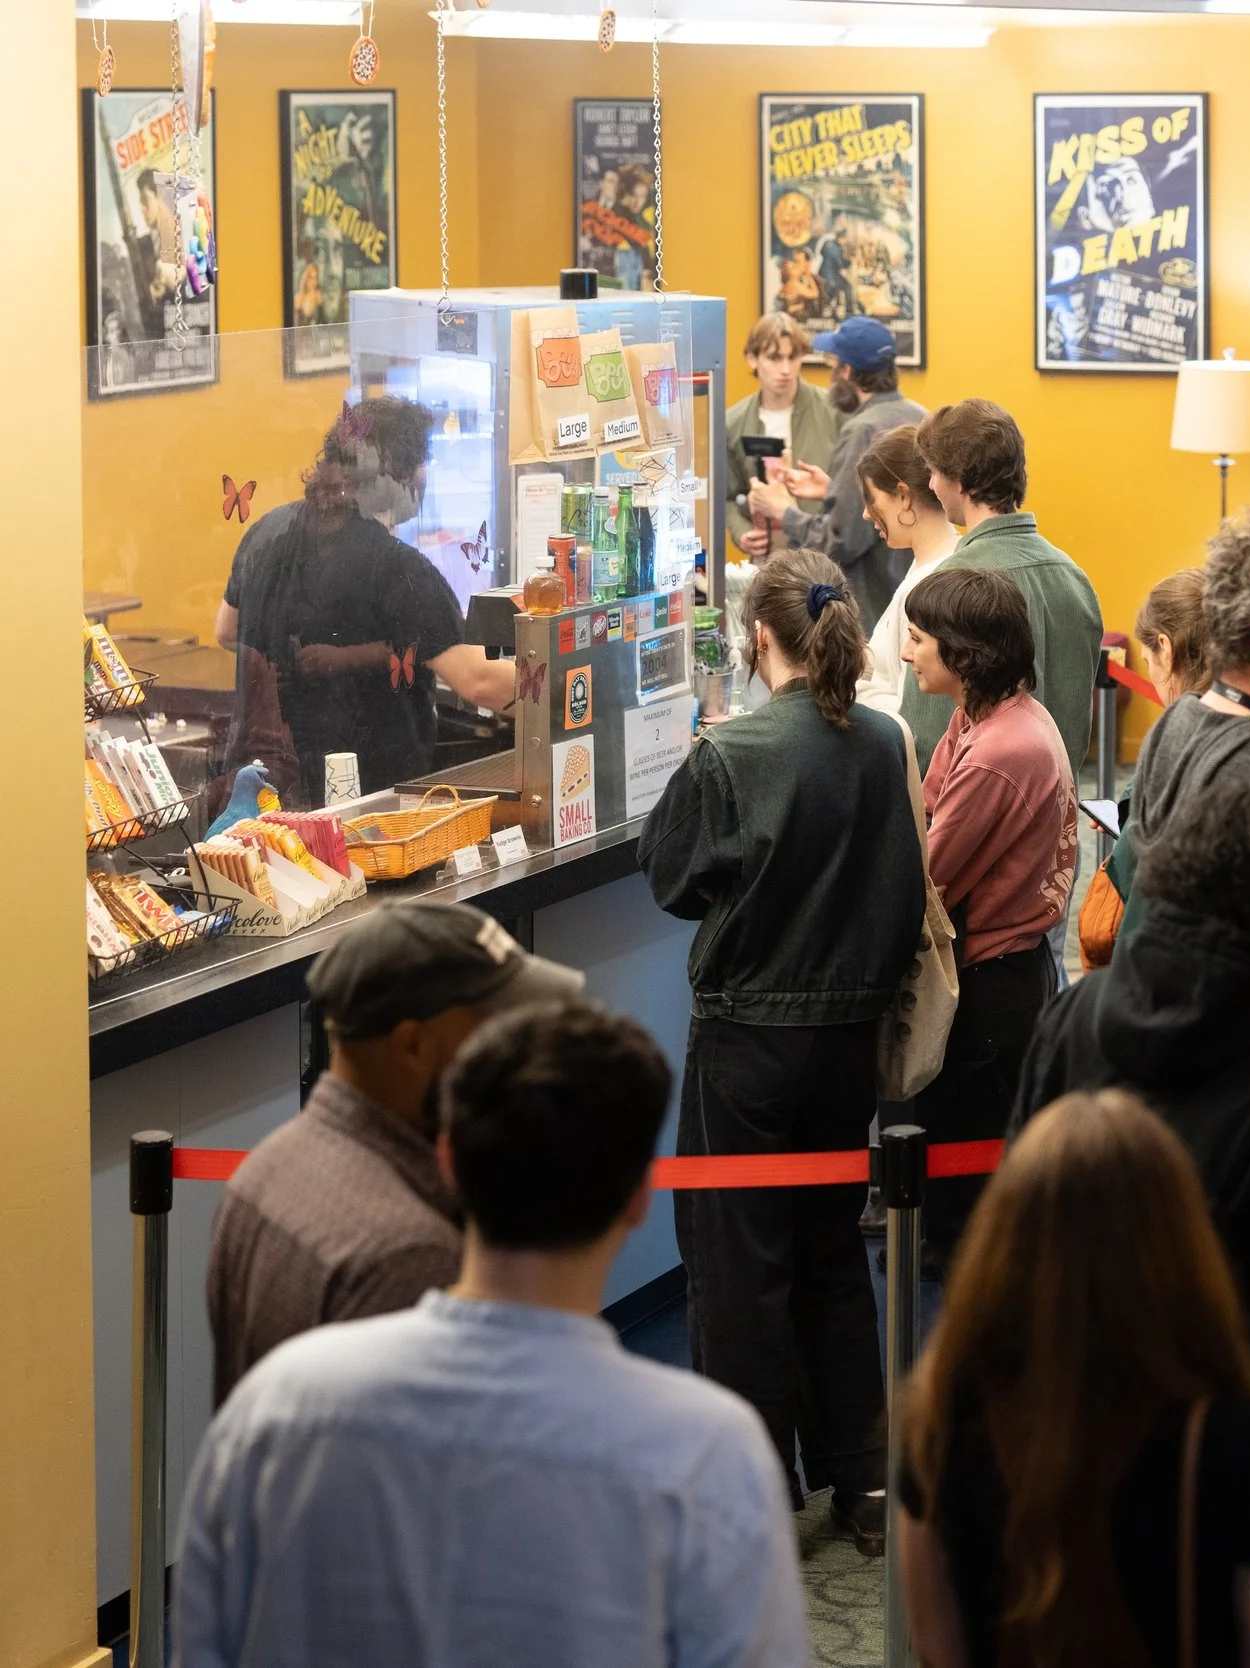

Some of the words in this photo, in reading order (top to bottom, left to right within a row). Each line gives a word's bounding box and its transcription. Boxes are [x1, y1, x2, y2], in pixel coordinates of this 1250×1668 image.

[771, 116, 813, 153] CITY
[814, 104, 864, 139] THAT
[116, 128, 148, 169] SIDE
[296, 124, 338, 175] NIGHT
[773, 141, 840, 180] NEVER
[841, 119, 912, 165] SLEEPS
[1048, 116, 1148, 186] KISS
[1152, 107, 1191, 144] OF
[303, 183, 387, 265] ADVENTURE
[1050, 205, 1190, 286] DEATH
[559, 419, 588, 439] Large
[607, 420, 639, 437] Medium
[680, 480, 699, 494] Small
[676, 539, 701, 554] Medium
[660, 571, 682, 588] Large
[642, 655, 667, 675] 2004
[643, 710, 666, 722] MAXIMUM
[666, 707, 673, 716] OF
[655, 728, 660, 741] 2
[145, 748, 176, 803] Junior
[559, 798, 593, 829] SMALL
[560, 822, 583, 842] BAKING
[583, 819, 593, 834] CO.
